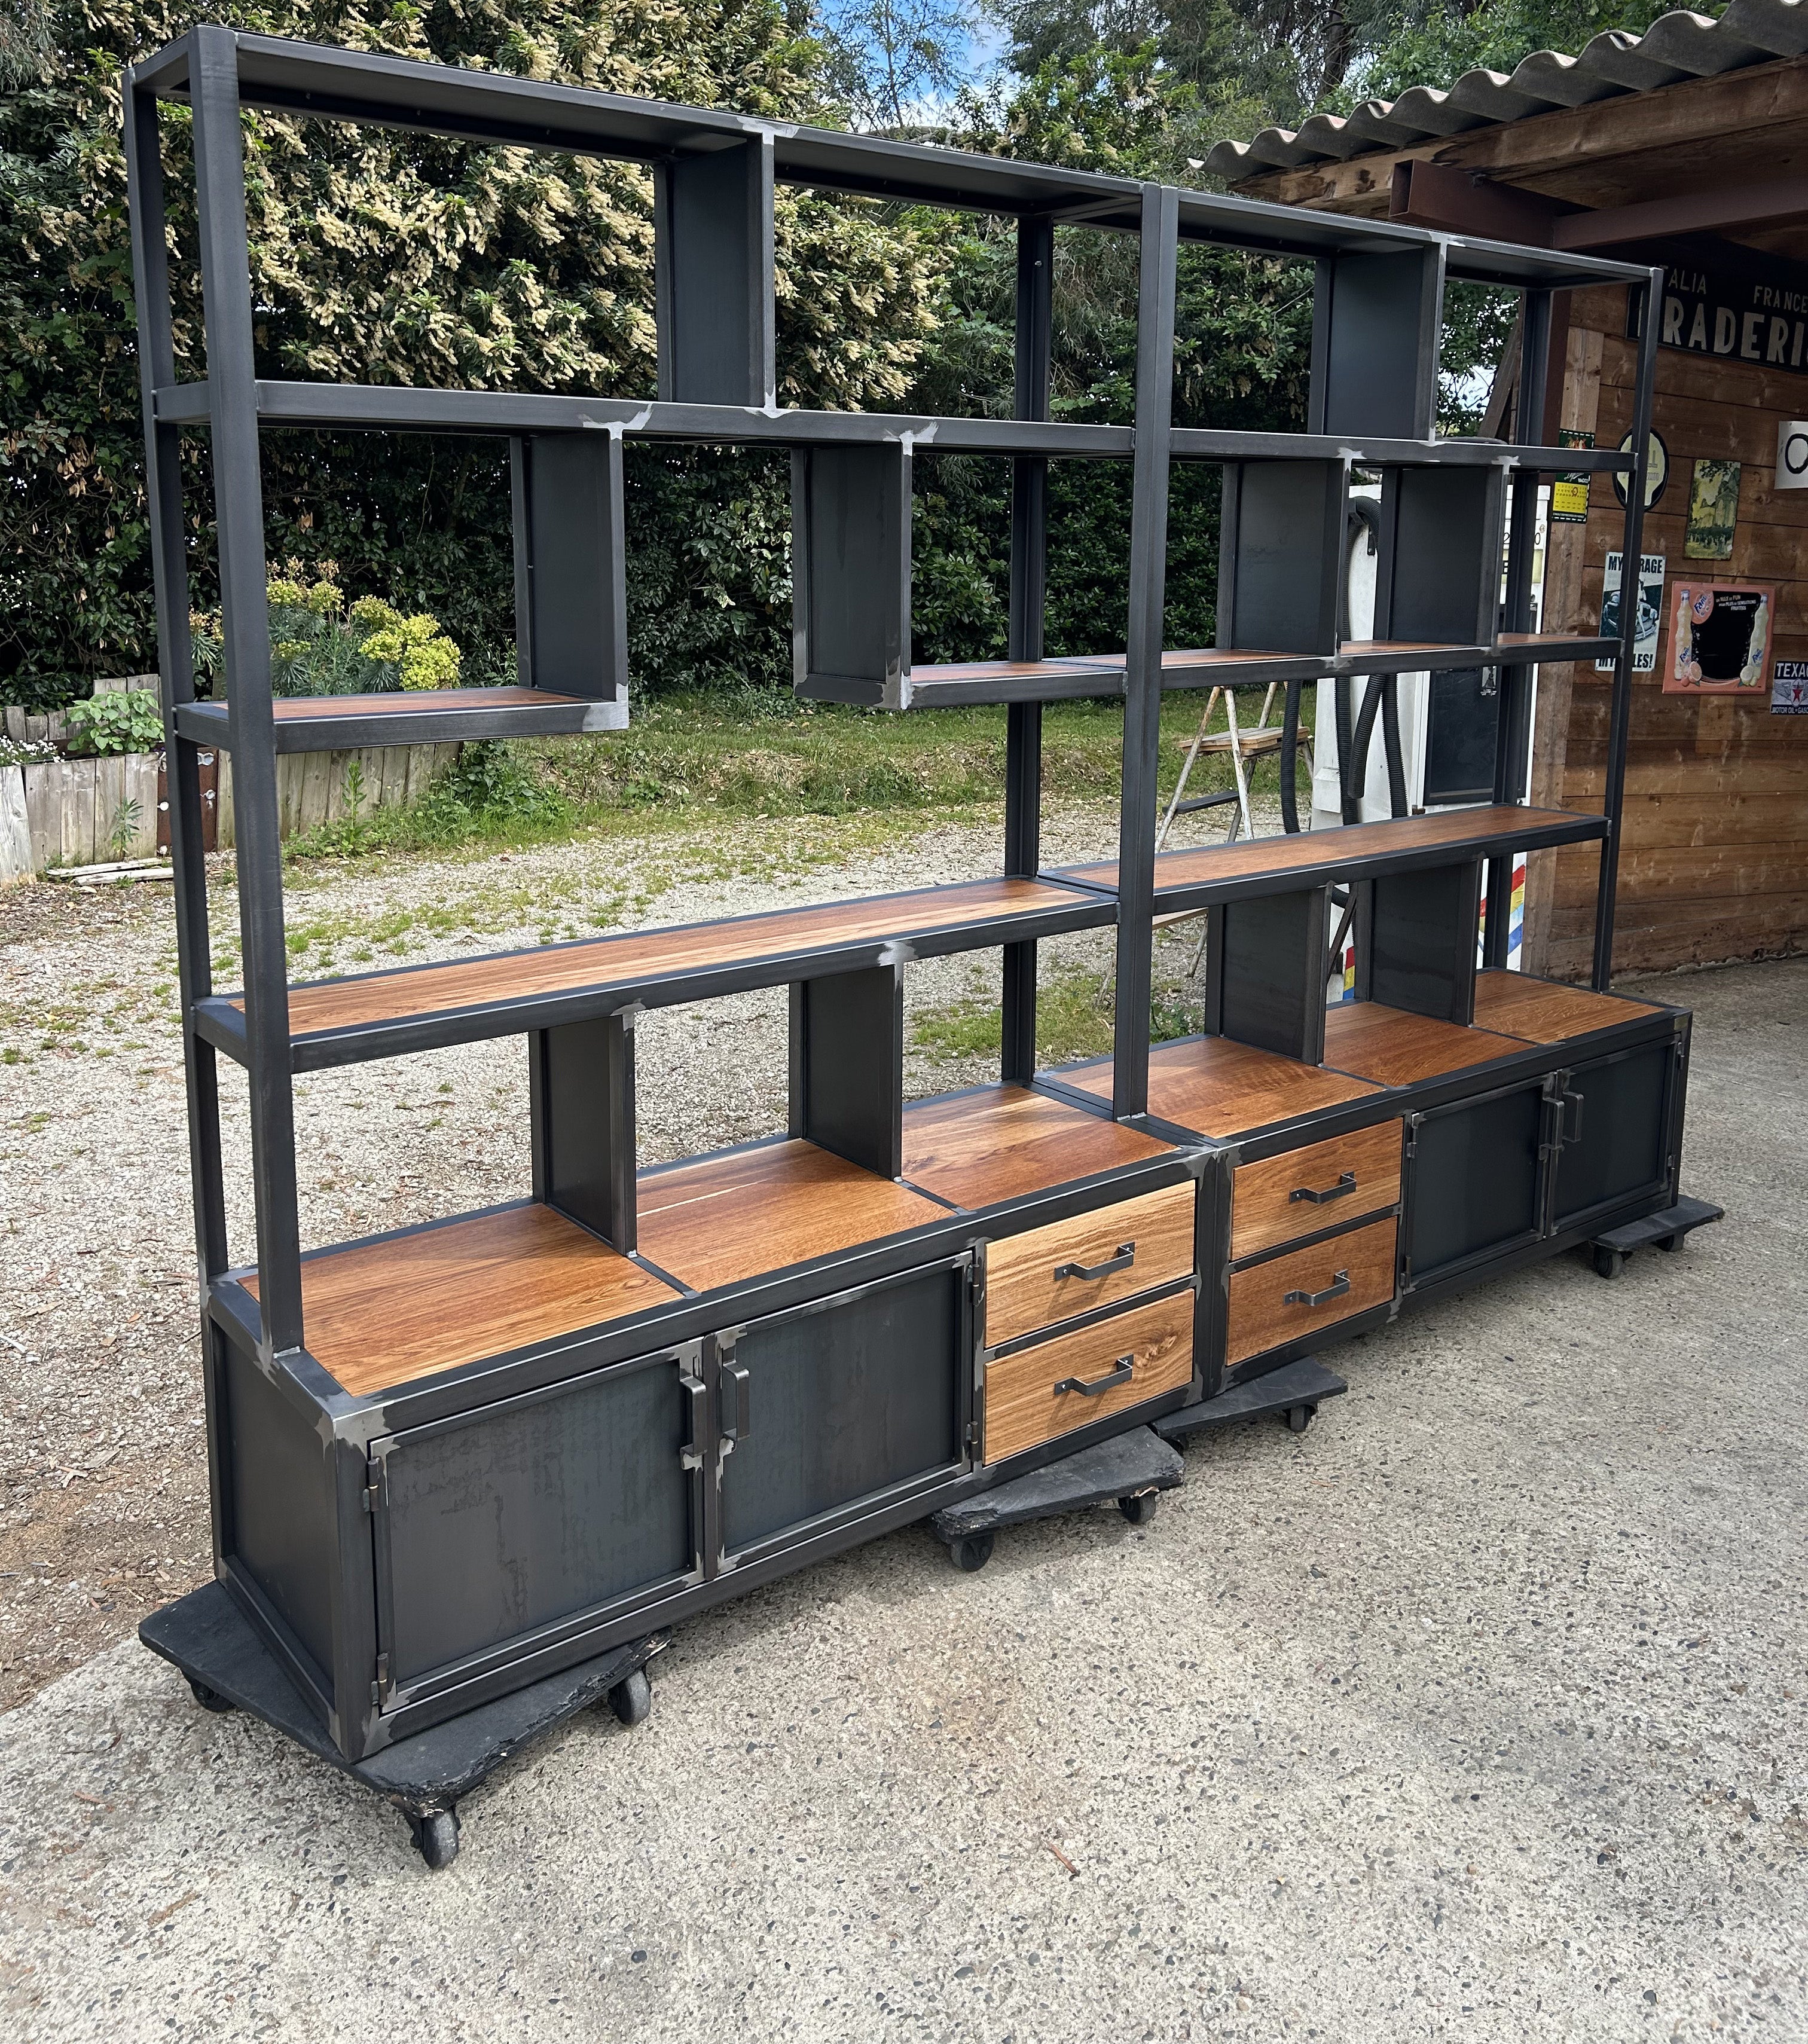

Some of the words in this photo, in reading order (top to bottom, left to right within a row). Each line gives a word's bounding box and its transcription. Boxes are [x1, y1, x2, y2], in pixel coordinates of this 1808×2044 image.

[1658, 264, 1707, 295] ALIA
[1638, 289, 1808, 366] RADERI
[1608, 555, 1623, 571] MY
[1640, 558, 1662, 573] RAGE
[1633, 653, 1653, 668] LES!
[1776, 662, 1808, 677] TEXA
